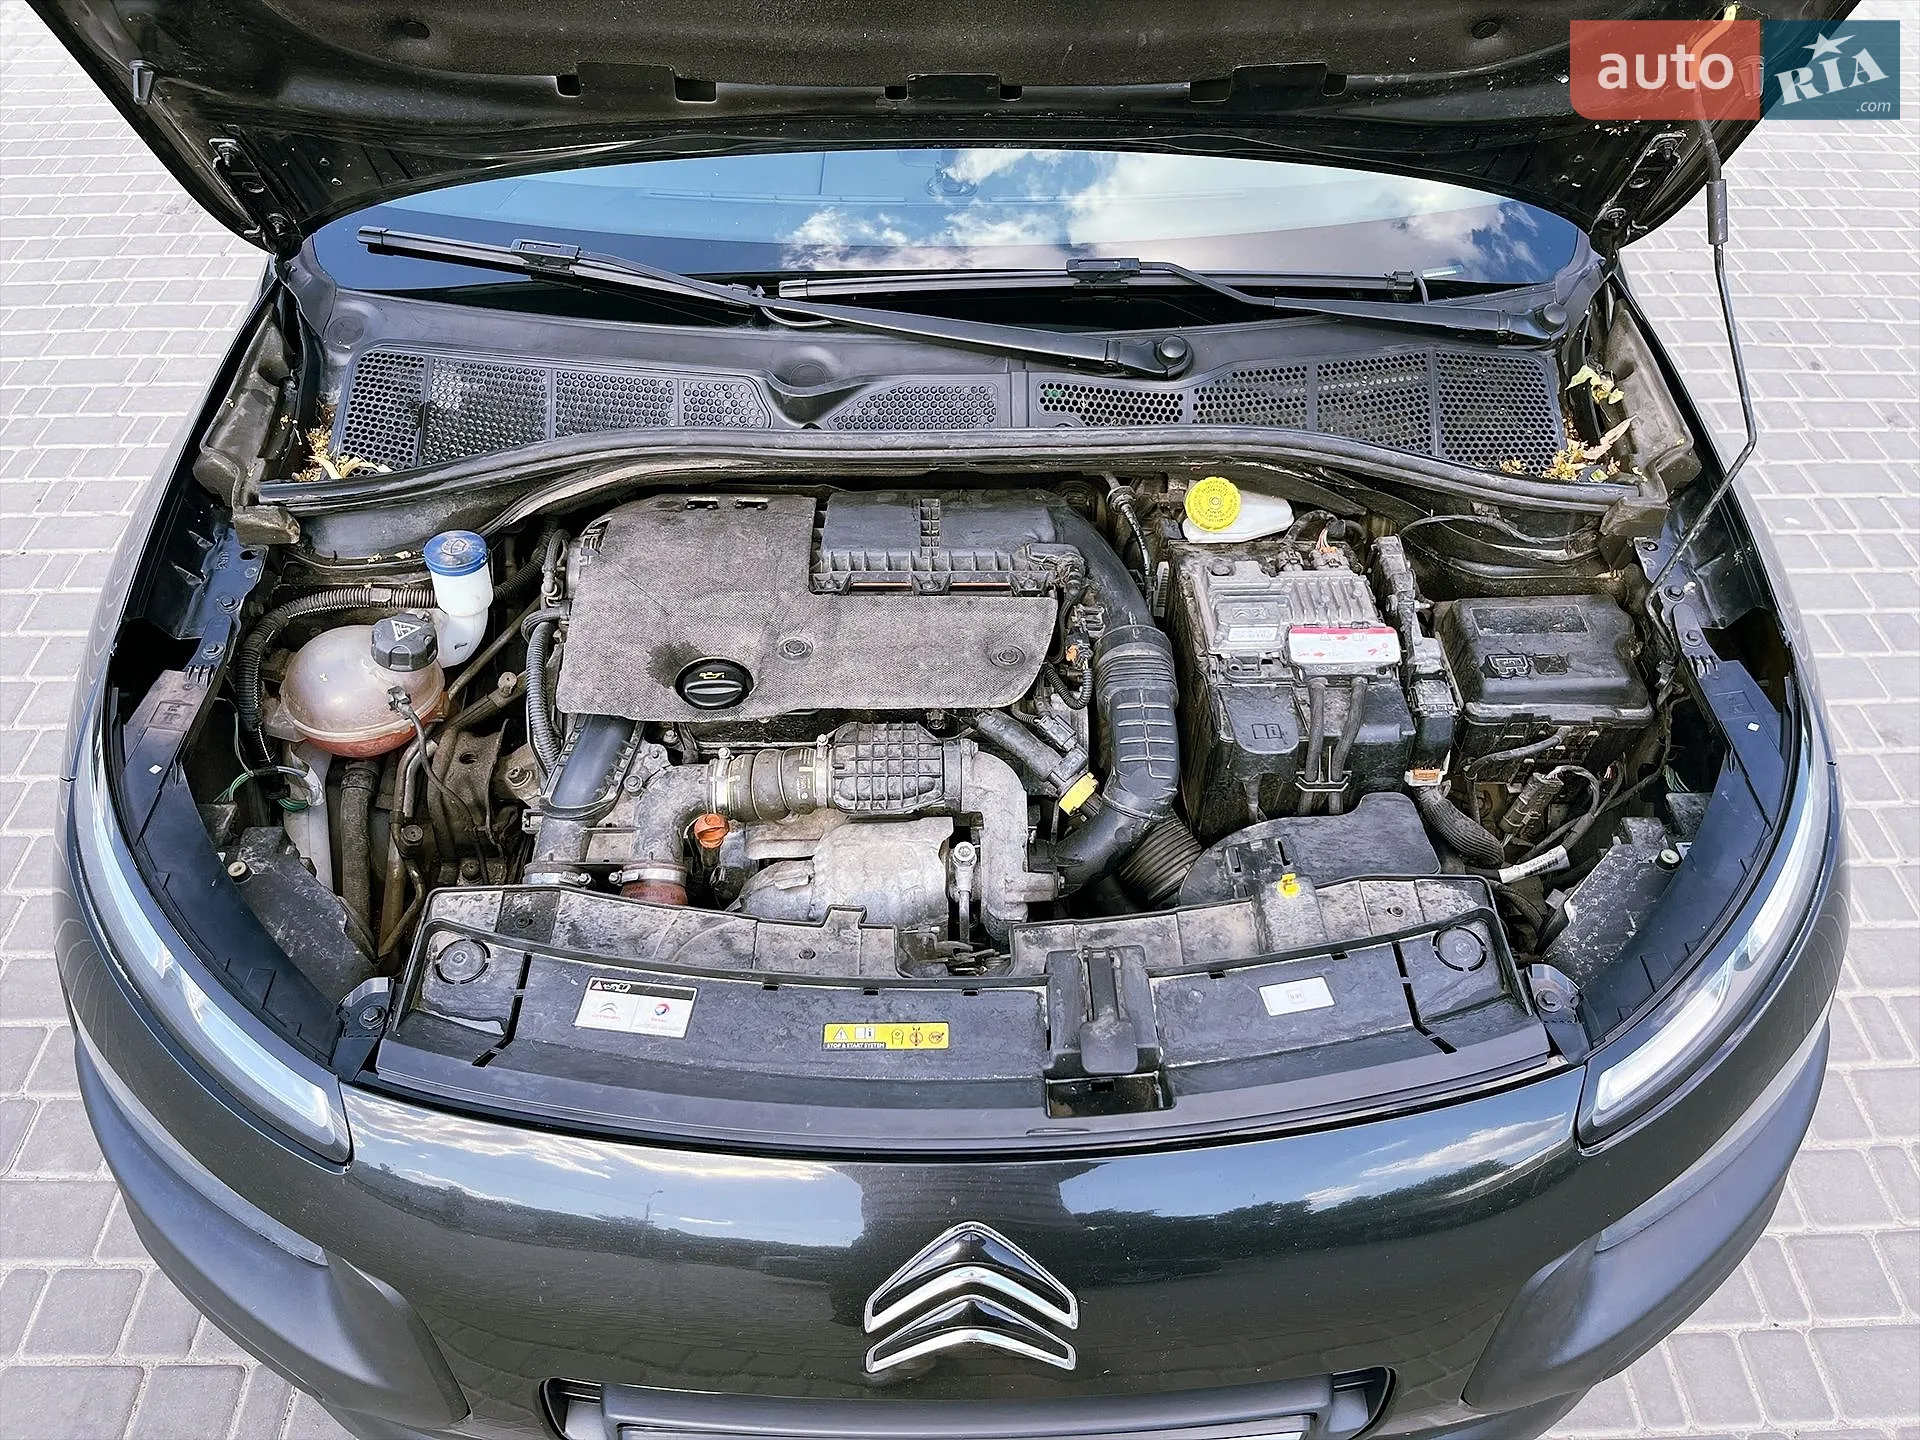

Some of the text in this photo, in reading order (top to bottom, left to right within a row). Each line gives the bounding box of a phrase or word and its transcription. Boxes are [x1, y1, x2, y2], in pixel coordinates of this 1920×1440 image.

[826, 1041, 842, 1049] STOP
[847, 1041, 864, 1049] START
[864, 1041, 885, 1049] SYSTEM
